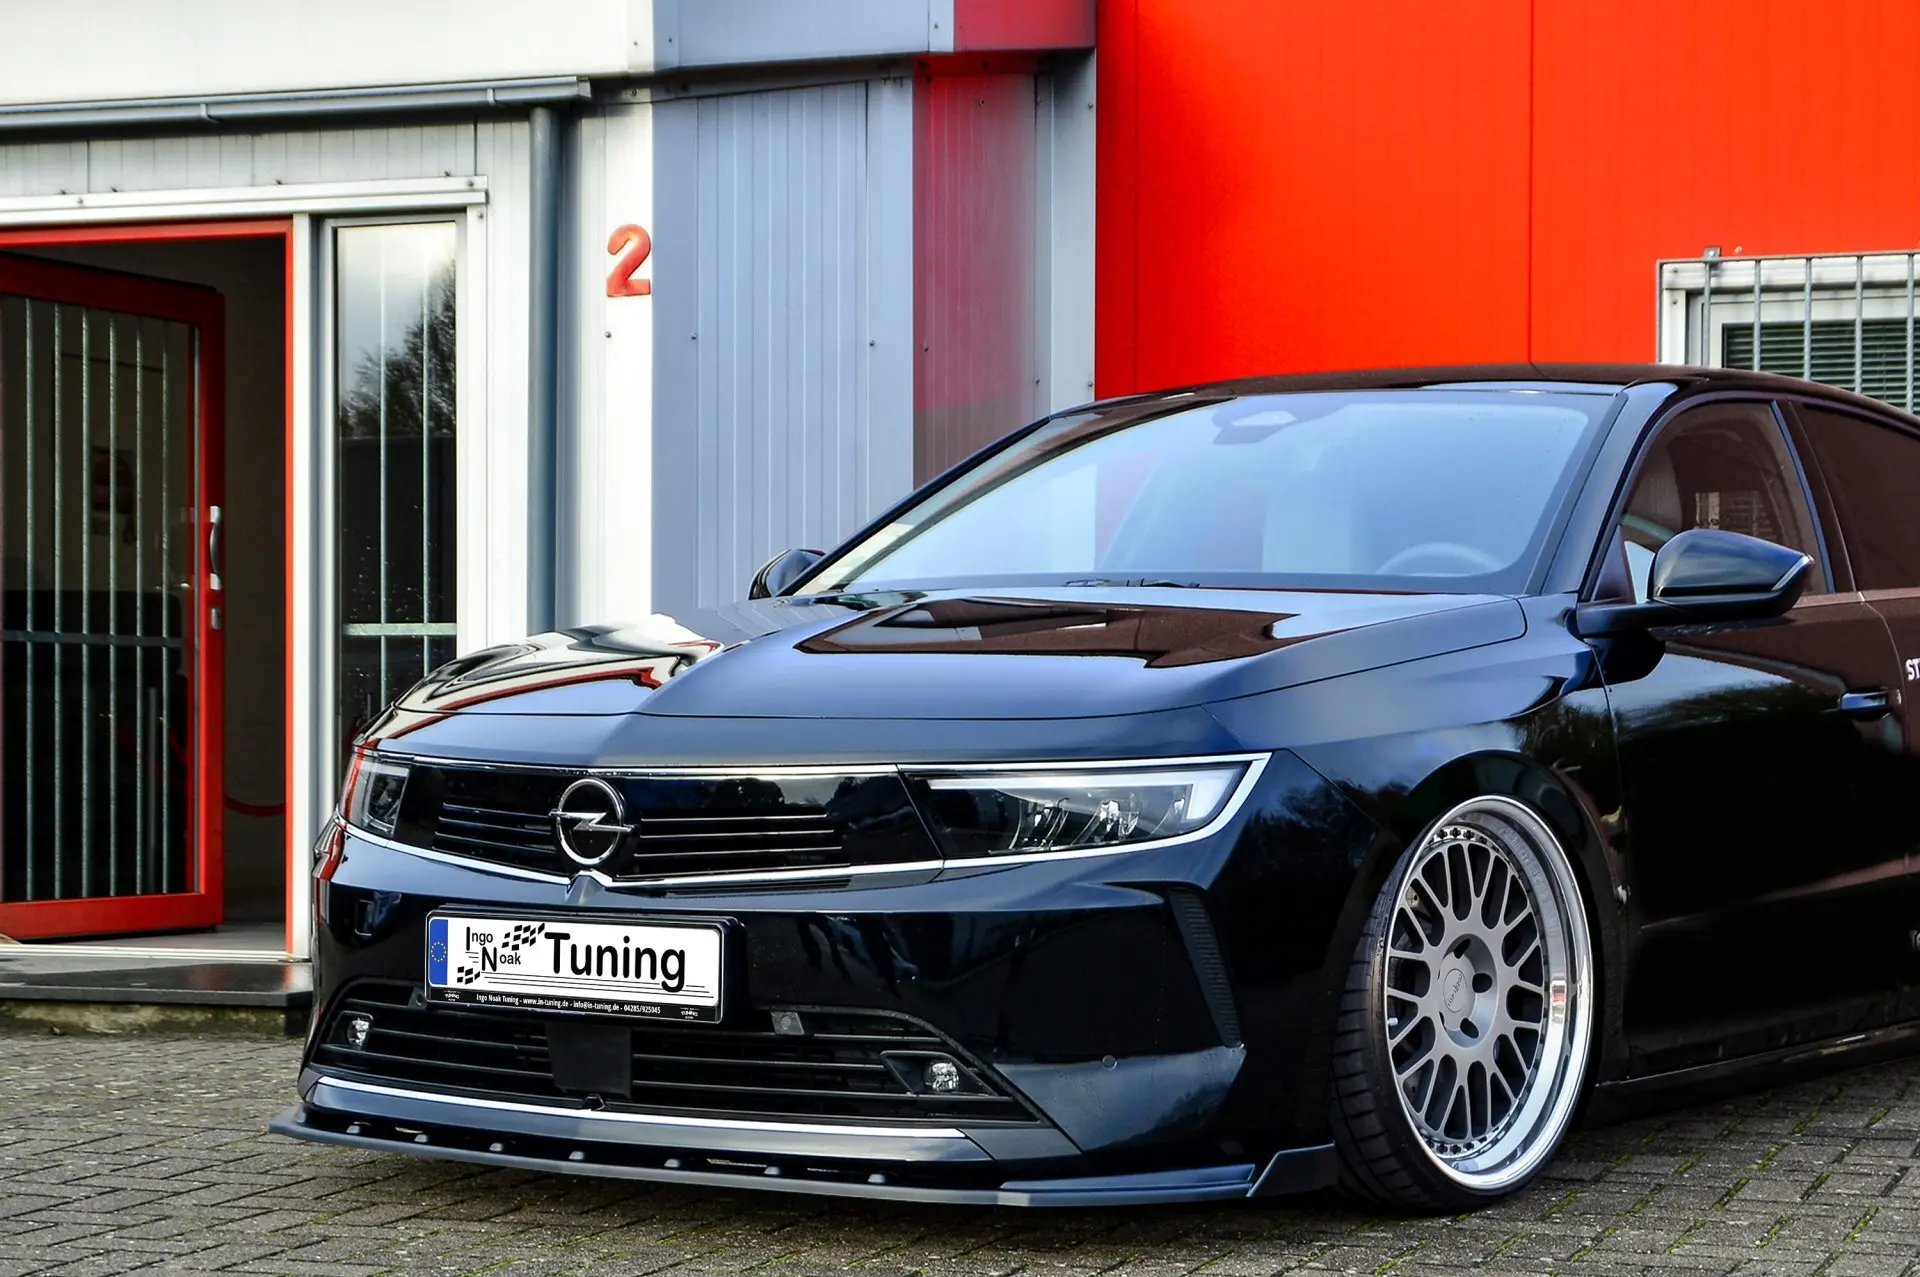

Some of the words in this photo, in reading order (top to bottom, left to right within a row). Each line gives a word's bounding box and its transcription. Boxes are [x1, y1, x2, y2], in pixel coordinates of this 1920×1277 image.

[607, 224, 652, 298] 2
[466, 926, 494, 951] Ingo
[482, 946, 521, 972] Noak
[544, 931, 686, 993] Tuning
[476, 993, 488, 1003] Ingo
[488, 994, 502, 1003] Noak
[502, 995, 519, 1006] Tuning
[523, 997, 569, 1009] www.in-tuning.de
